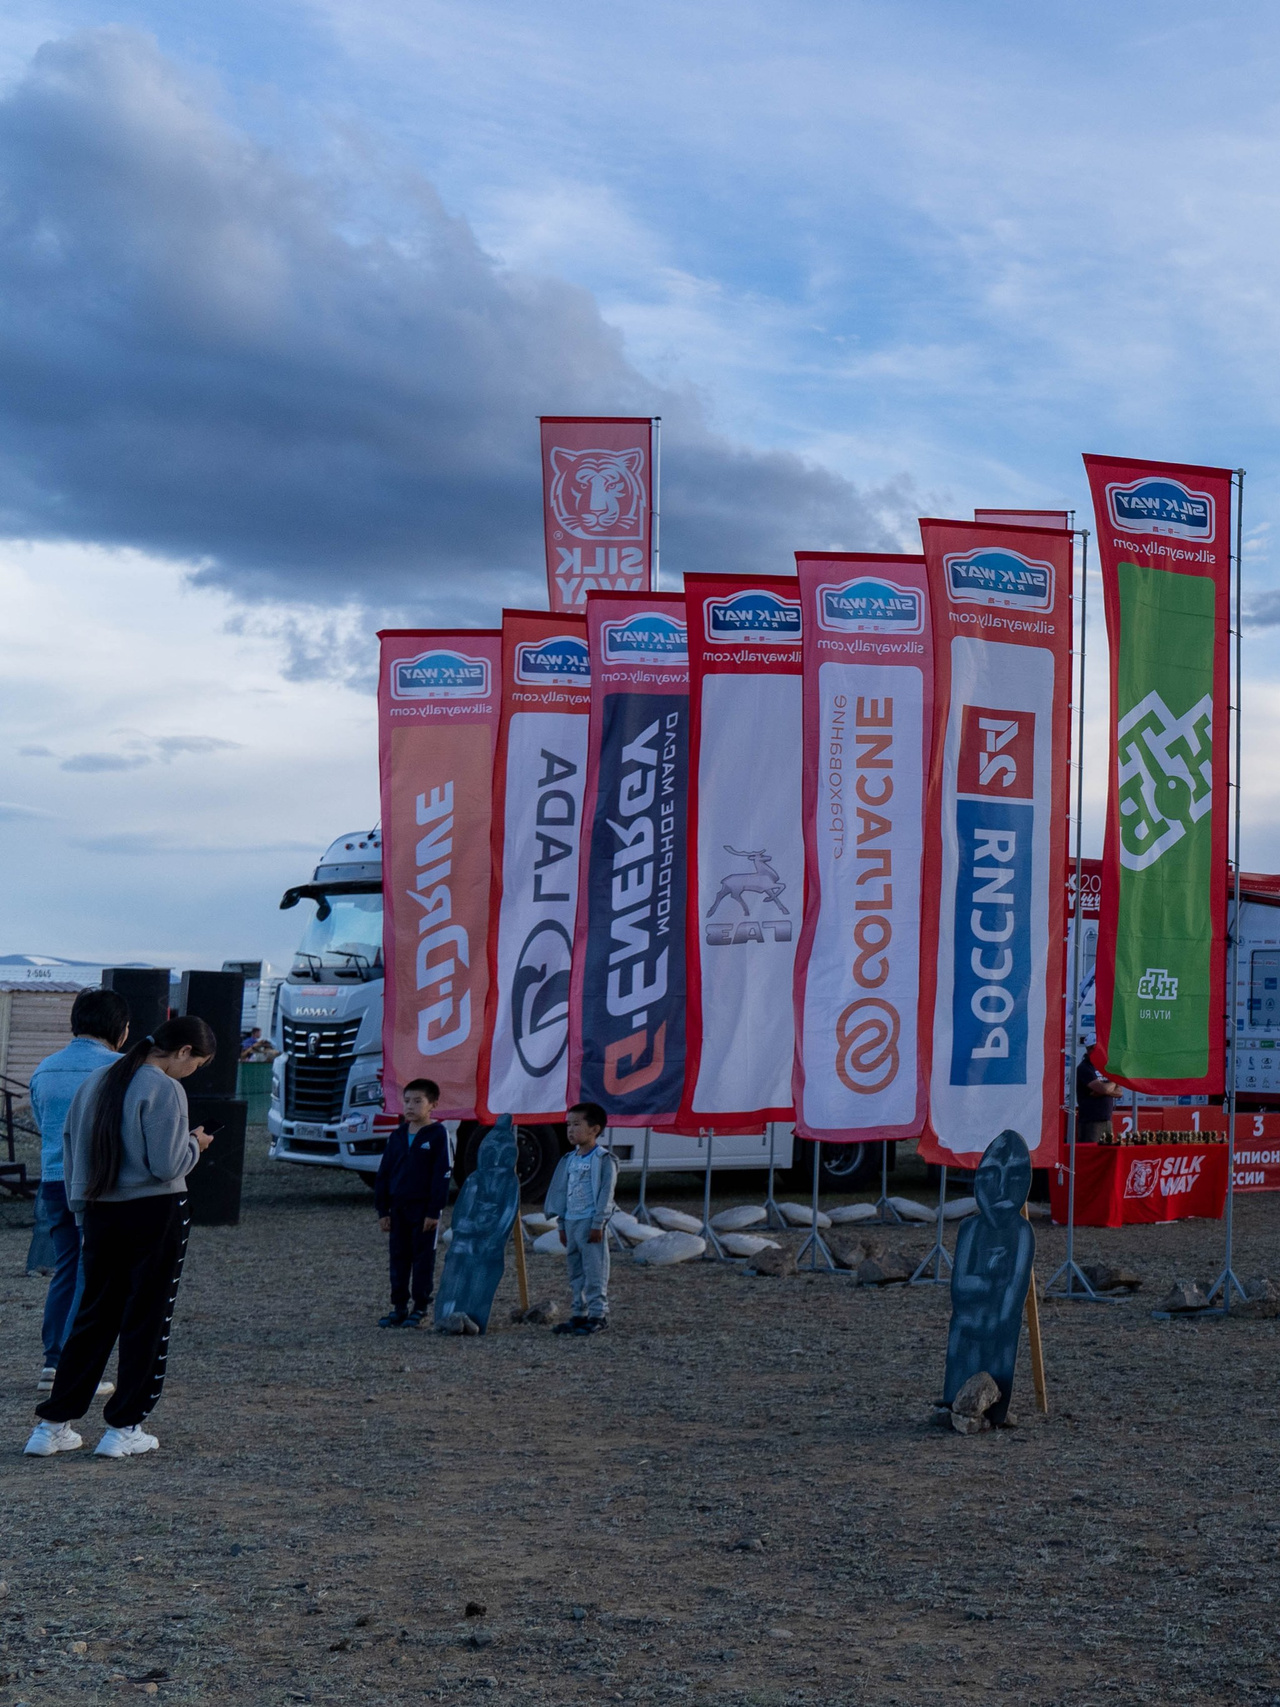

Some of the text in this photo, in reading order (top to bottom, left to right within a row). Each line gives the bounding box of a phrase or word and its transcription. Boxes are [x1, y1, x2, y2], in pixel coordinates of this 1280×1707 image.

[1121, 1116, 1133, 1139] 2
[1191, 1111, 1200, 1132] 1
[1252, 1115, 1264, 1137] 3
[1160, 1155, 1206, 1176] SILK
[1159, 1174, 1200, 1197] WAY
[1234, 1171, 1265, 1186] ссии
